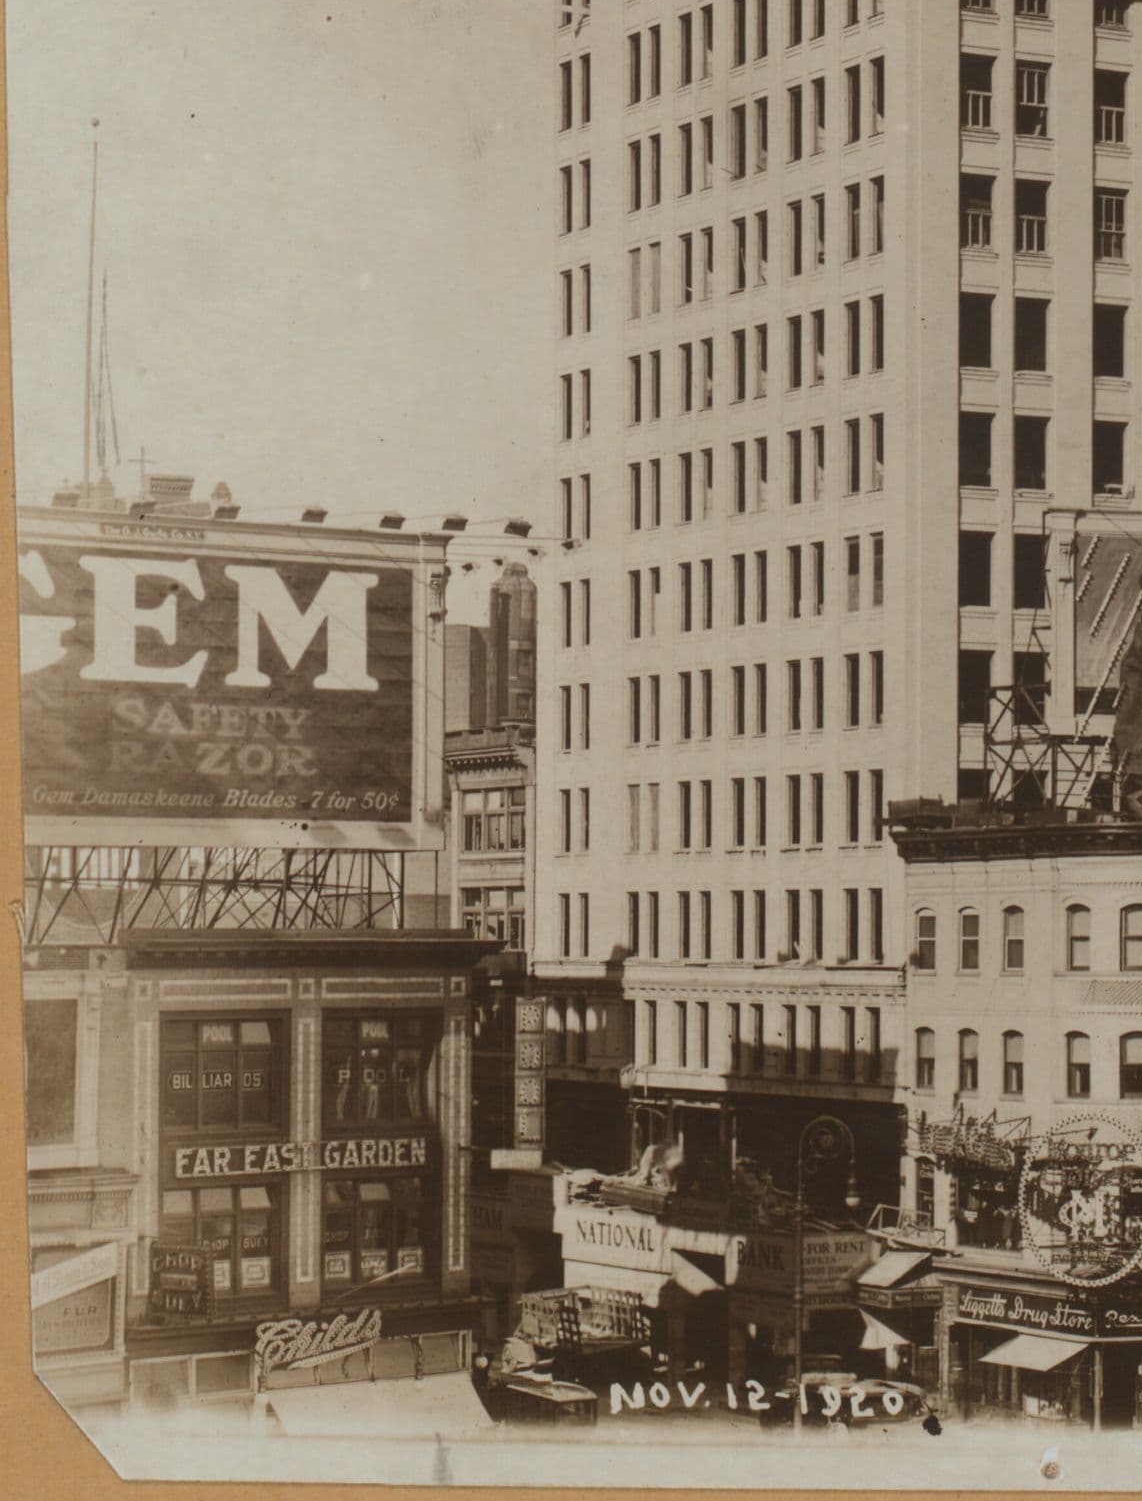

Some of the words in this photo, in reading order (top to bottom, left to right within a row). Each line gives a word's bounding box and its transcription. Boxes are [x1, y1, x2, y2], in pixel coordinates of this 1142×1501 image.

[111, 699, 313, 740] SAFETY
[108, 738, 319, 778] RAZOR
[33, 785, 76, 803] Gem
[80, 786, 214, 807] Damaskeene
[222, 788, 297, 808] Blades
[311, 789, 322, 808] 7
[325, 790, 358, 810] for
[360, 791, 400, 809] 50¢
[202, 1026, 233, 1042] POOL
[361, 1021, 390, 1040] POOL
[175, 1146, 232, 1178] FAR
[244, 1143, 314, 1174] EAST
[323, 1137, 427, 1169] GARDEN
[576, 1219, 655, 1253] NATIONAL
[736, 1240, 786, 1271] BANK
[806, 1241, 833, 1255] FOR
[834, 1240, 866, 1254] RENT
[1008, 1295, 1049, 1329] Drug
[1049, 1301, 1094, 1331] Store
[254, 1309, 382, 1370] Childs
